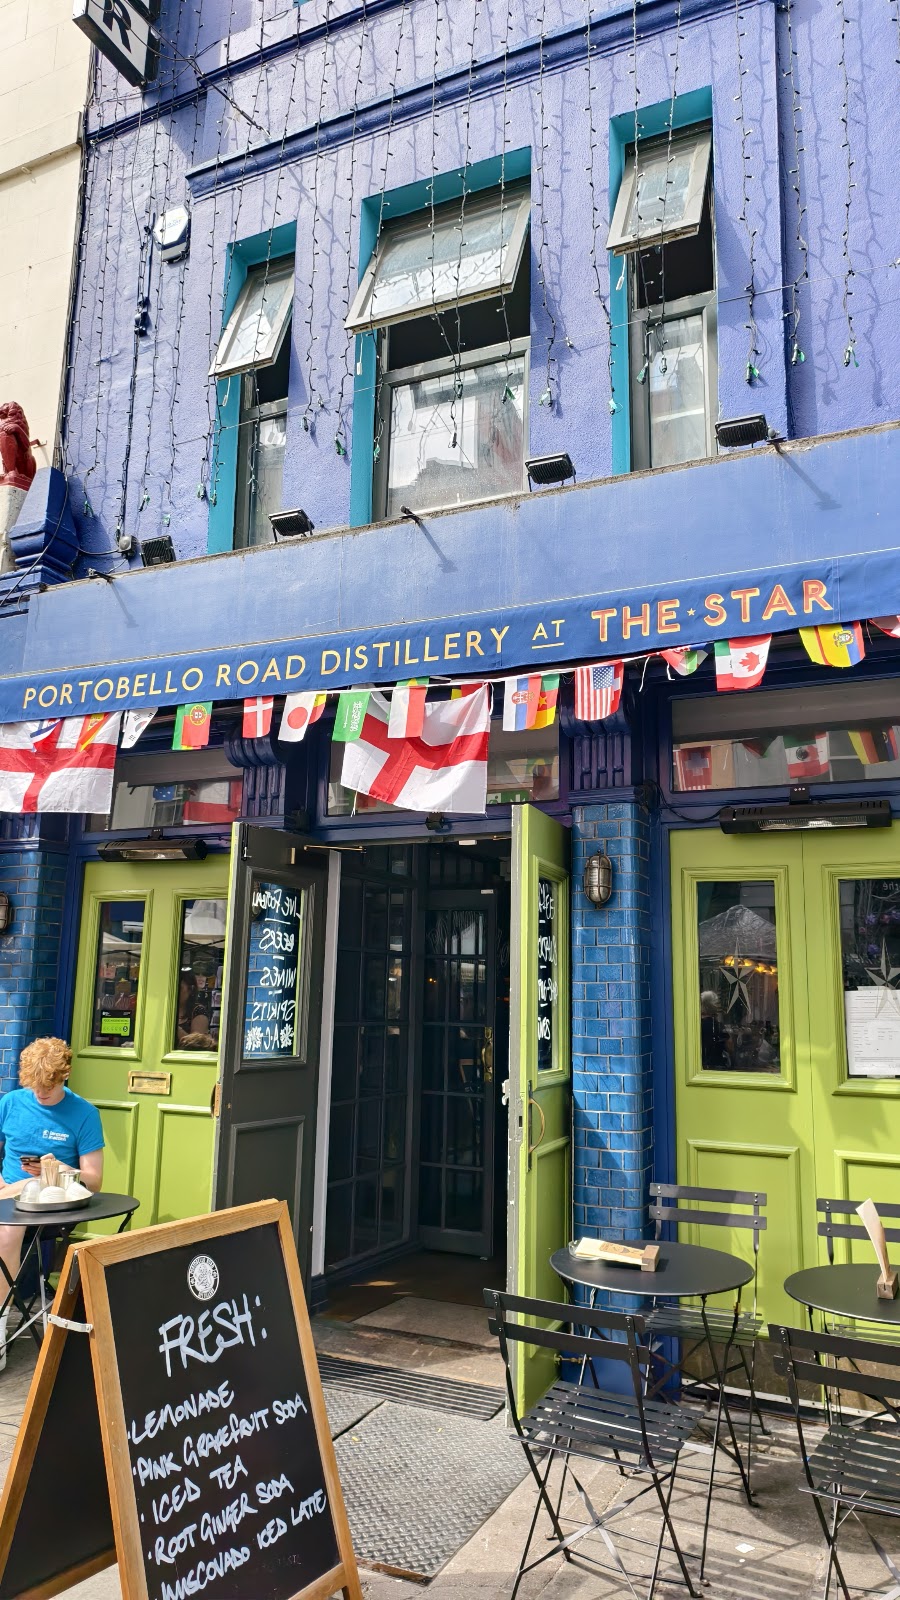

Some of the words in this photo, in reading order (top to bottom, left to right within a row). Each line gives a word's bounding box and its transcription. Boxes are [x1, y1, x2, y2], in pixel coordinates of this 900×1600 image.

[22, 667, 204, 709] PORTOBELLO
[215, 655, 306, 687] ROAD
[320, 625, 510, 675] DISTILLERY
[532, 619, 565, 641] AT
[591, 598, 681, 643] THE
[703, 579, 834, 627] STAR
[158, 1293, 268, 1378] FRESH:
[131, 1380, 235, 1444] LEMONADE
[137, 1452, 182, 1486] PINK
[183, 1409, 269, 1467] GRAPEFRUIT
[272, 1393, 308, 1424] SODA
[152, 1477, 201, 1524] ICED
[209, 1455, 248, 1489] TEA
[154, 1523, 197, 1566] ROOT
[200, 1493, 258, 1545] GINGER
[256, 1473, 295, 1504] SODA
[161, 1546, 250, 1600] MUSCOVADO
[256, 1517, 287, 1550] ICED
[290, 1488, 327, 1526] LATTE
